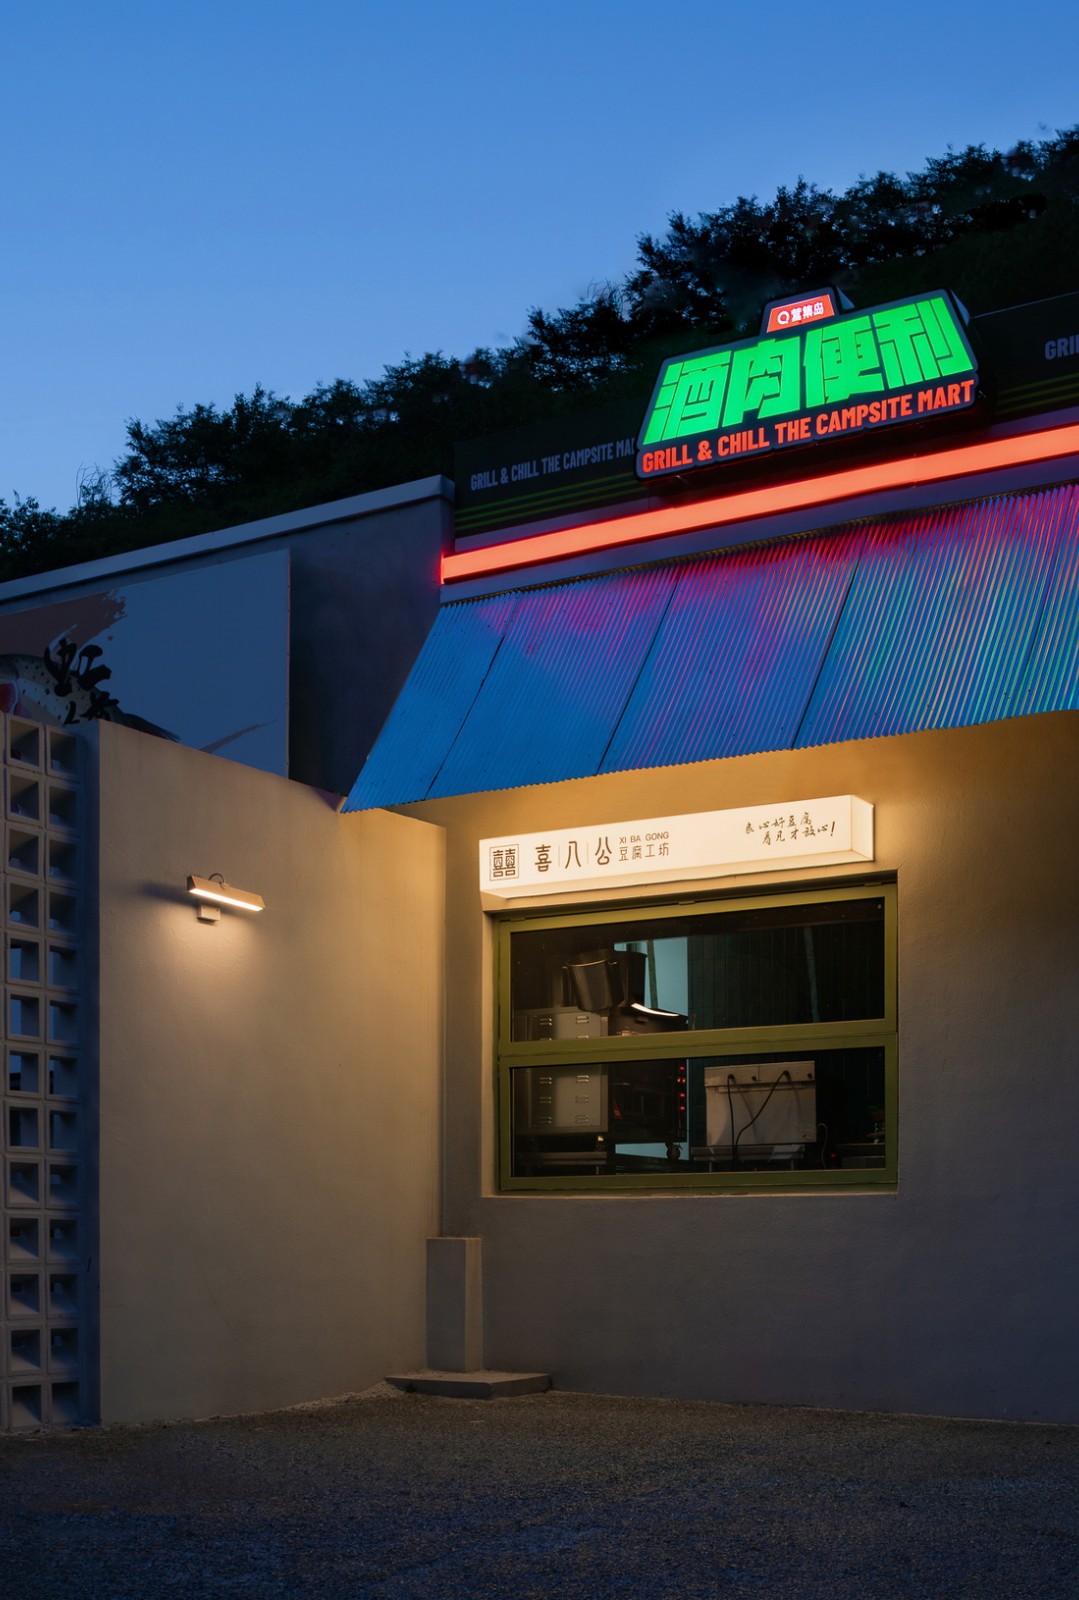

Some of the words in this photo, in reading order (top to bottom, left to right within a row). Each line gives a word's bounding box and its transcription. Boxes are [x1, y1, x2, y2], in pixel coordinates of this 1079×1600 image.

[642, 297, 975, 446] 酒肉便利
[642, 441, 693, 474] GRILL
[698, 438, 713, 462] &
[717, 425, 770, 457] CHILL
[775, 416, 811, 444] THE
[816, 393, 914, 432] CAMPSITE
[918, 379, 975, 412] MART
[471, 470, 497, 490] GRILL
[501, 467, 508, 483] &
[511, 459, 538, 481] CHILL
[541, 454, 561, 474] THE
[563, 442, 613, 469] CAMPSITE
[534, 836, 612, 872] 喜八公
[619, 842, 669, 862] 豆腐工坊
[645, 832, 669, 841] GONG
